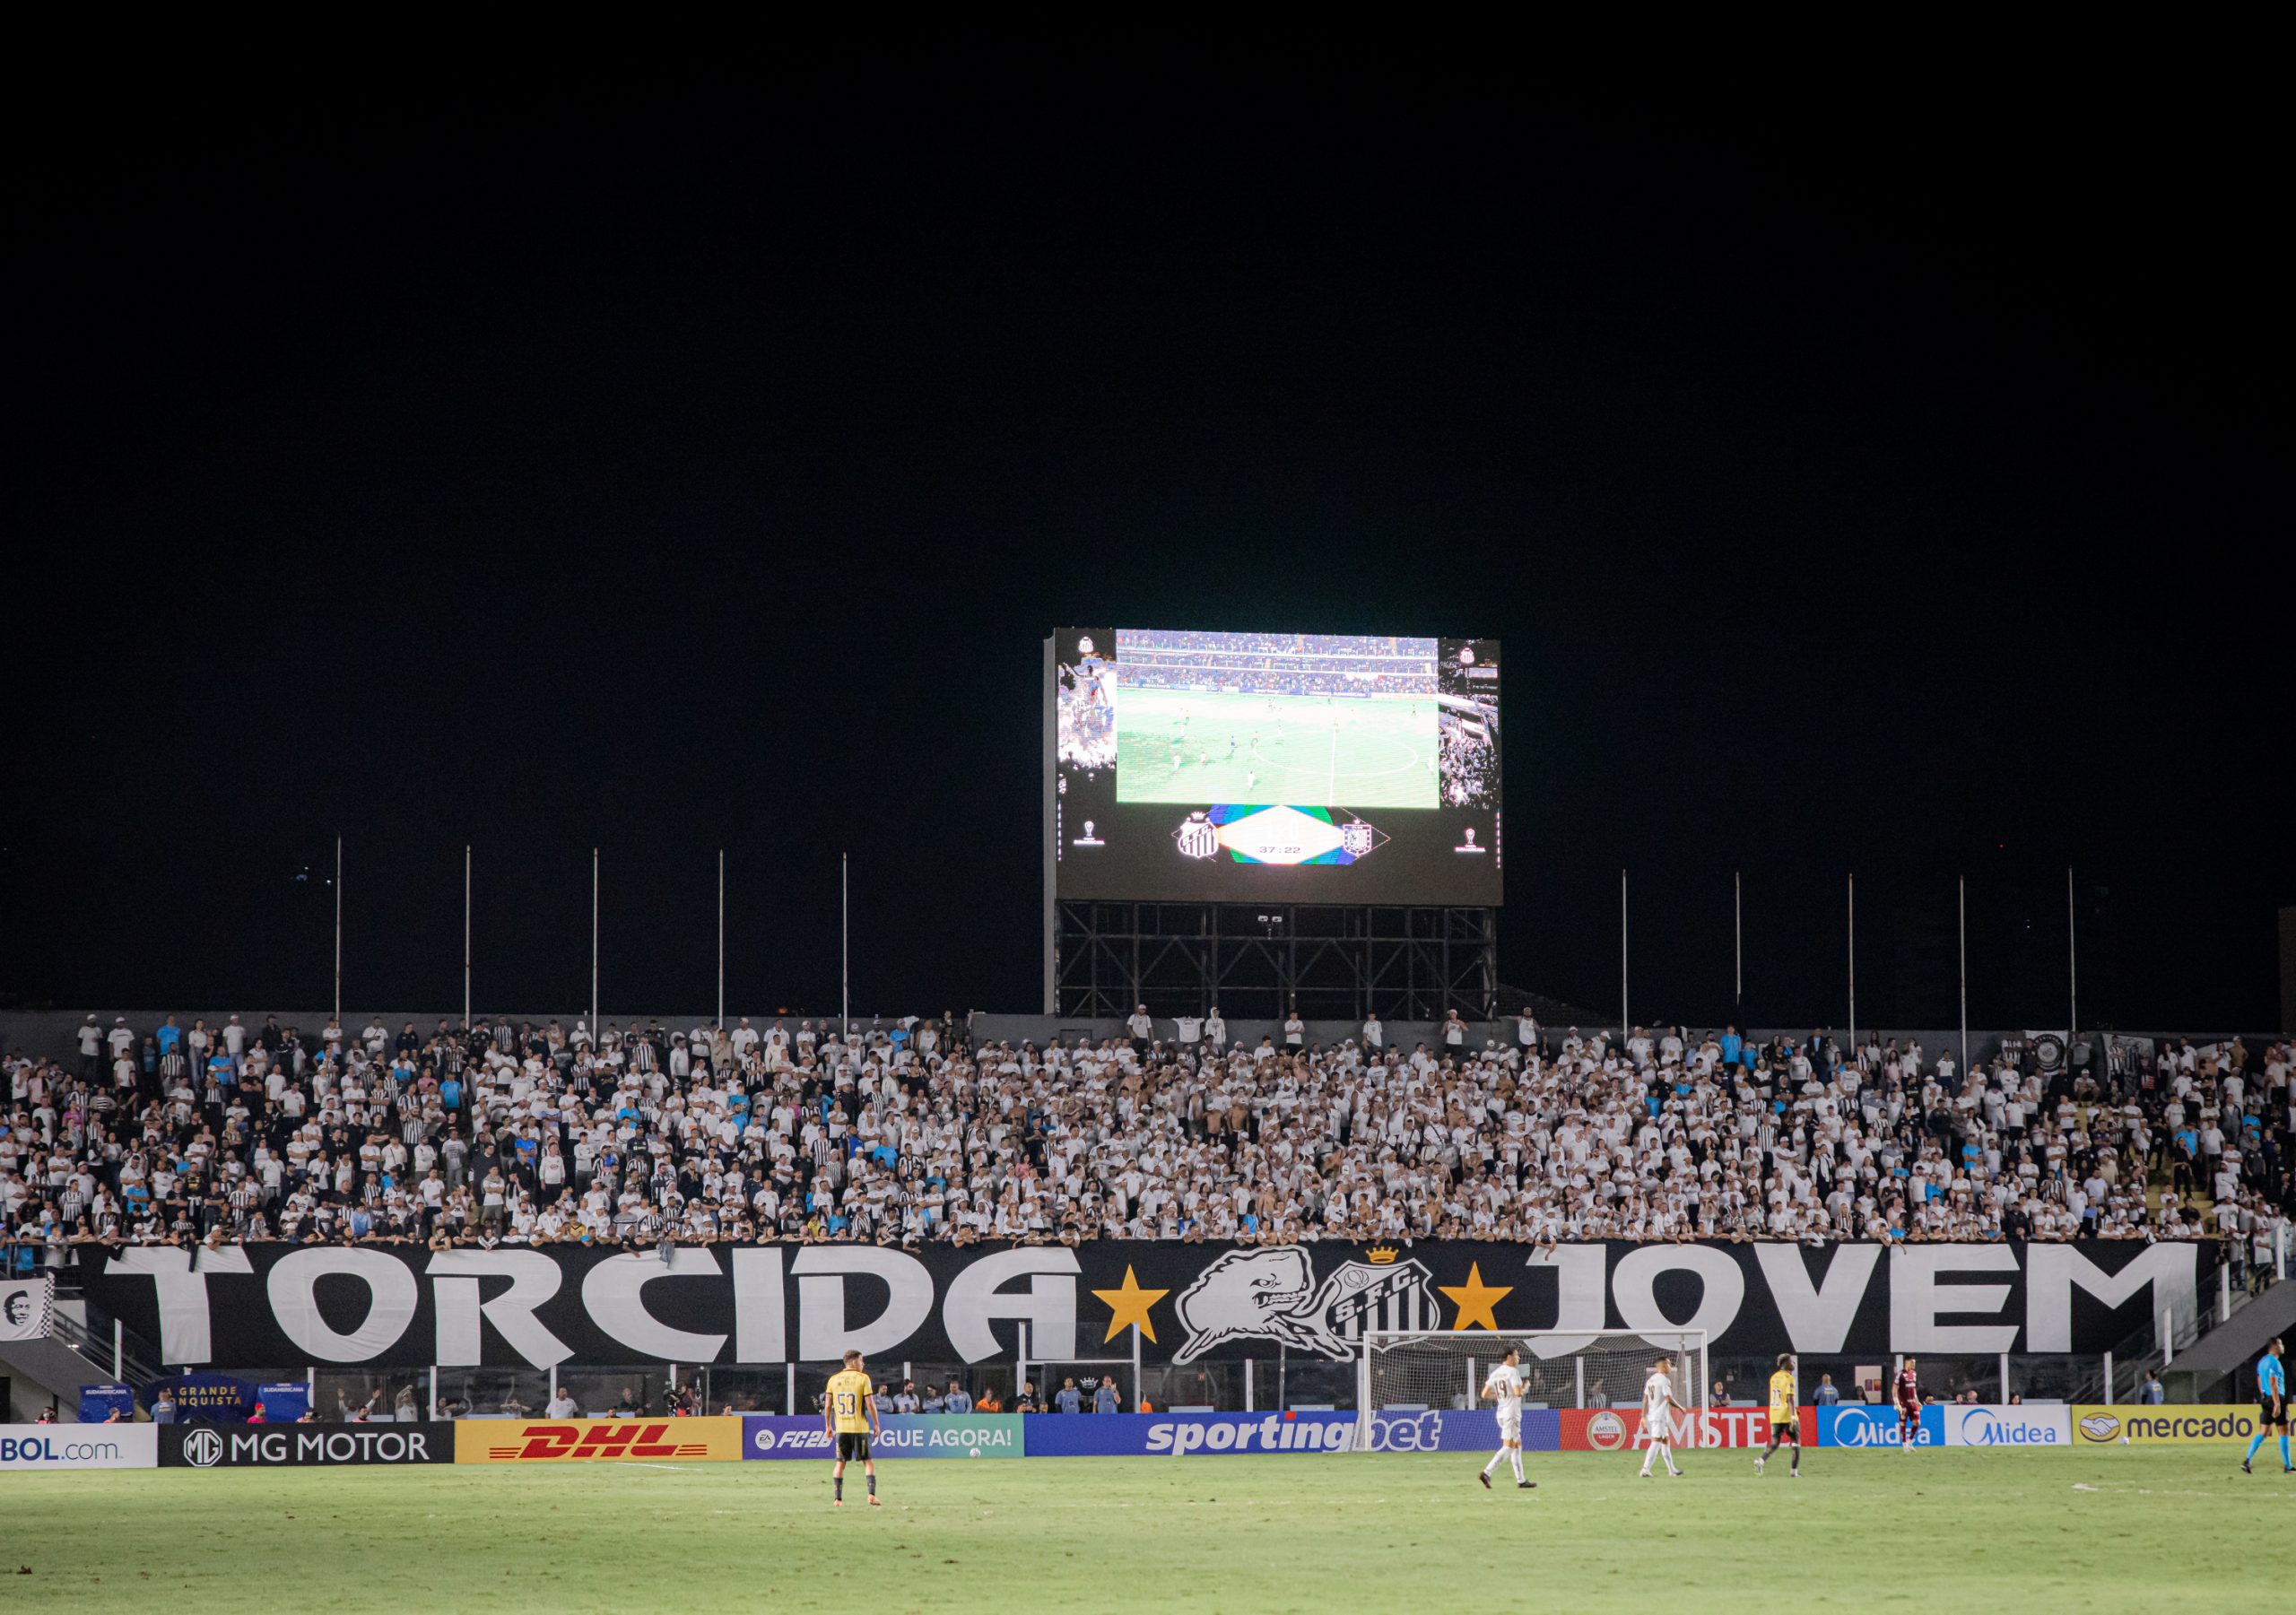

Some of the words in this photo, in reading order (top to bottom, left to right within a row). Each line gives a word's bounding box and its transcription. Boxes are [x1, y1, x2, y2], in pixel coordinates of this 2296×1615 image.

[1259, 846, 1300, 854] 37:22
[104, 1245, 1082, 1371] TORCIDA
[1524, 1241, 2198, 1360] JOVEM
[179, 1386, 237, 1396] GRANDE
[1494, 1379, 1508, 1398] 19
[837, 1393, 856, 1415] 53
[1979, 1421, 2057, 1444] Midea
[2126, 1412, 2253, 1437] mercado
[231, 1433, 287, 1462] MG
[297, 1432, 430, 1462] MOTOR
[518, 1424, 679, 1459] DHL
[928, 1428, 1012, 1446] AGORA!
